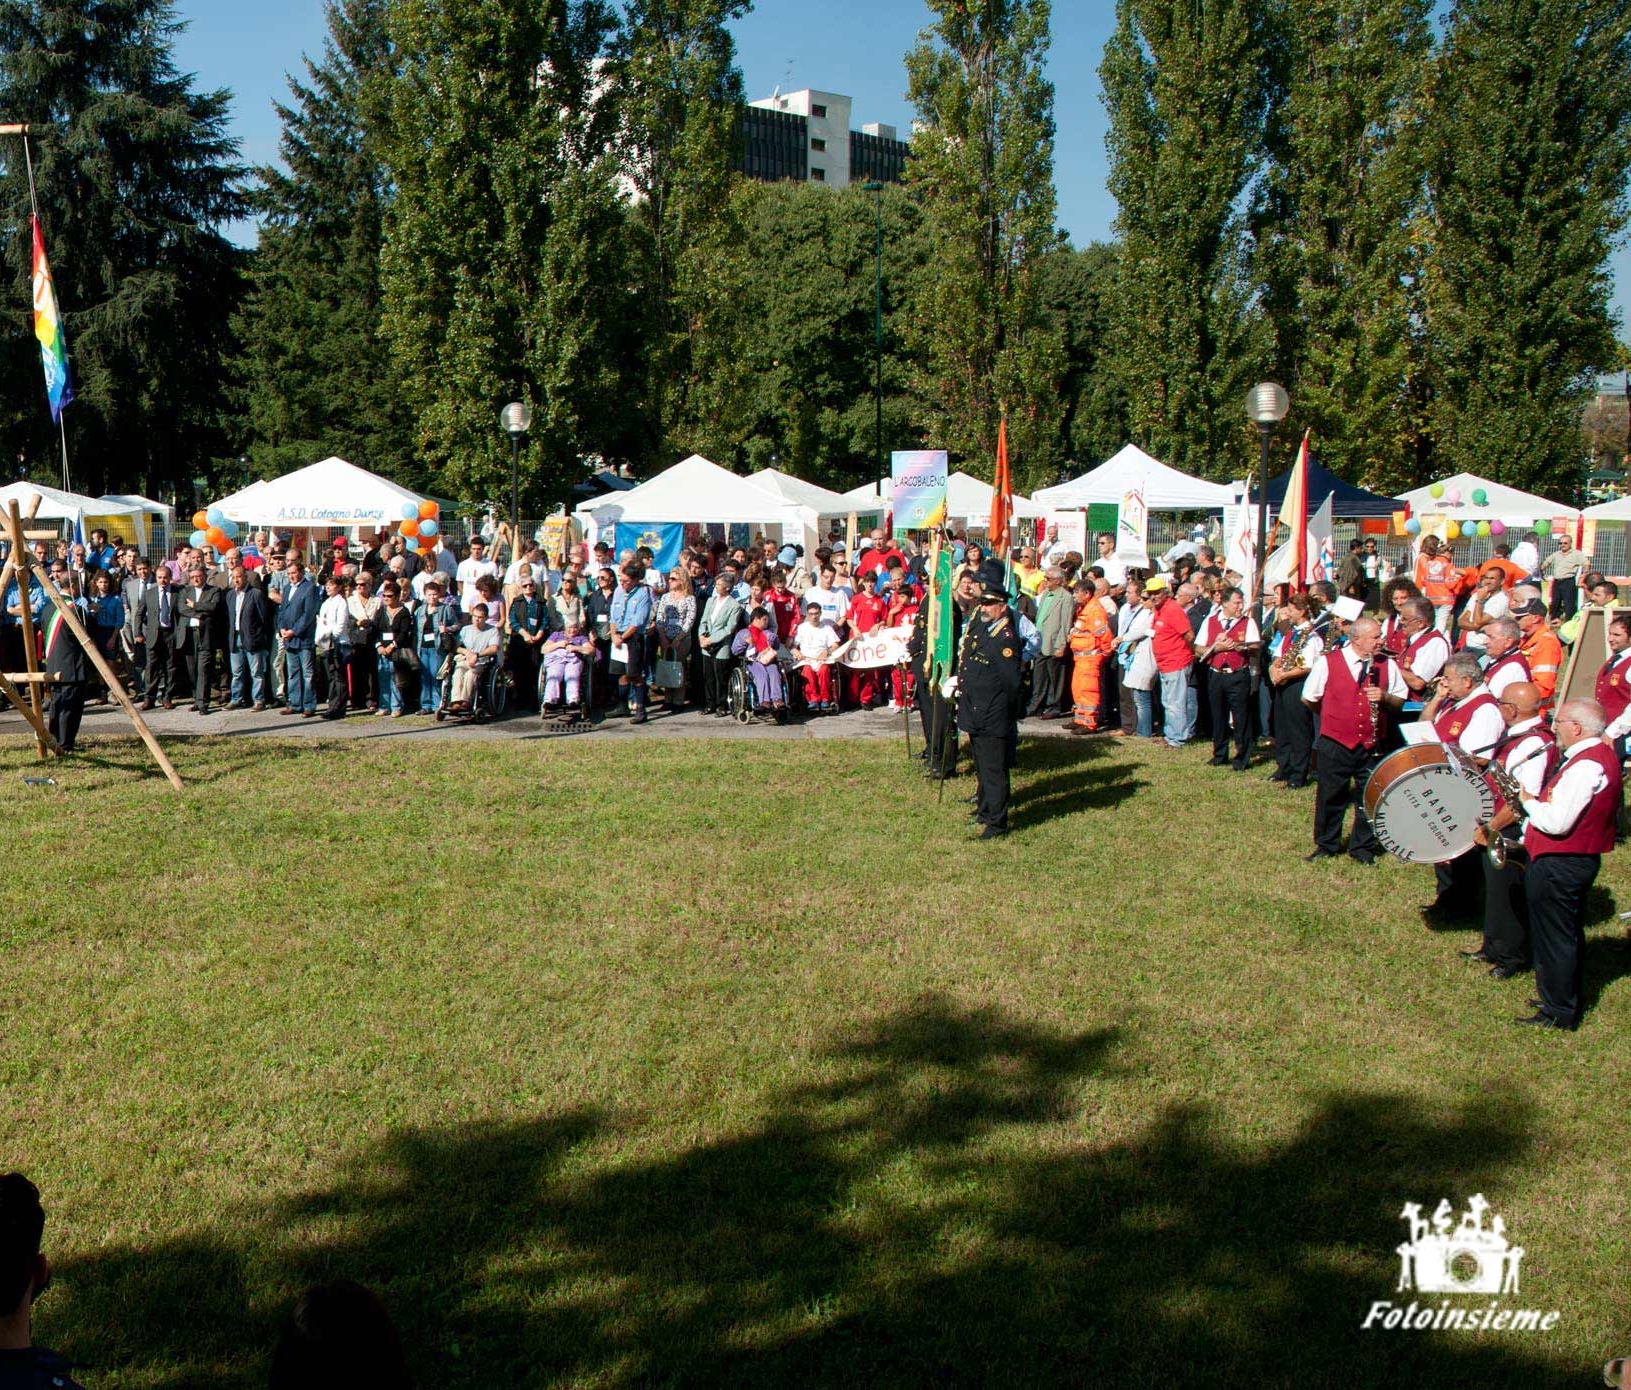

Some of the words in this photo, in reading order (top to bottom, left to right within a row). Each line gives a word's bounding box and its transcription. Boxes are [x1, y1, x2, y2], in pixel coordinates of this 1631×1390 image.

[894, 475, 946, 487] L'ARCOBALENO
[1422, 789, 1458, 832] BANDA
[1375, 811, 1415, 861] MUSICALE
